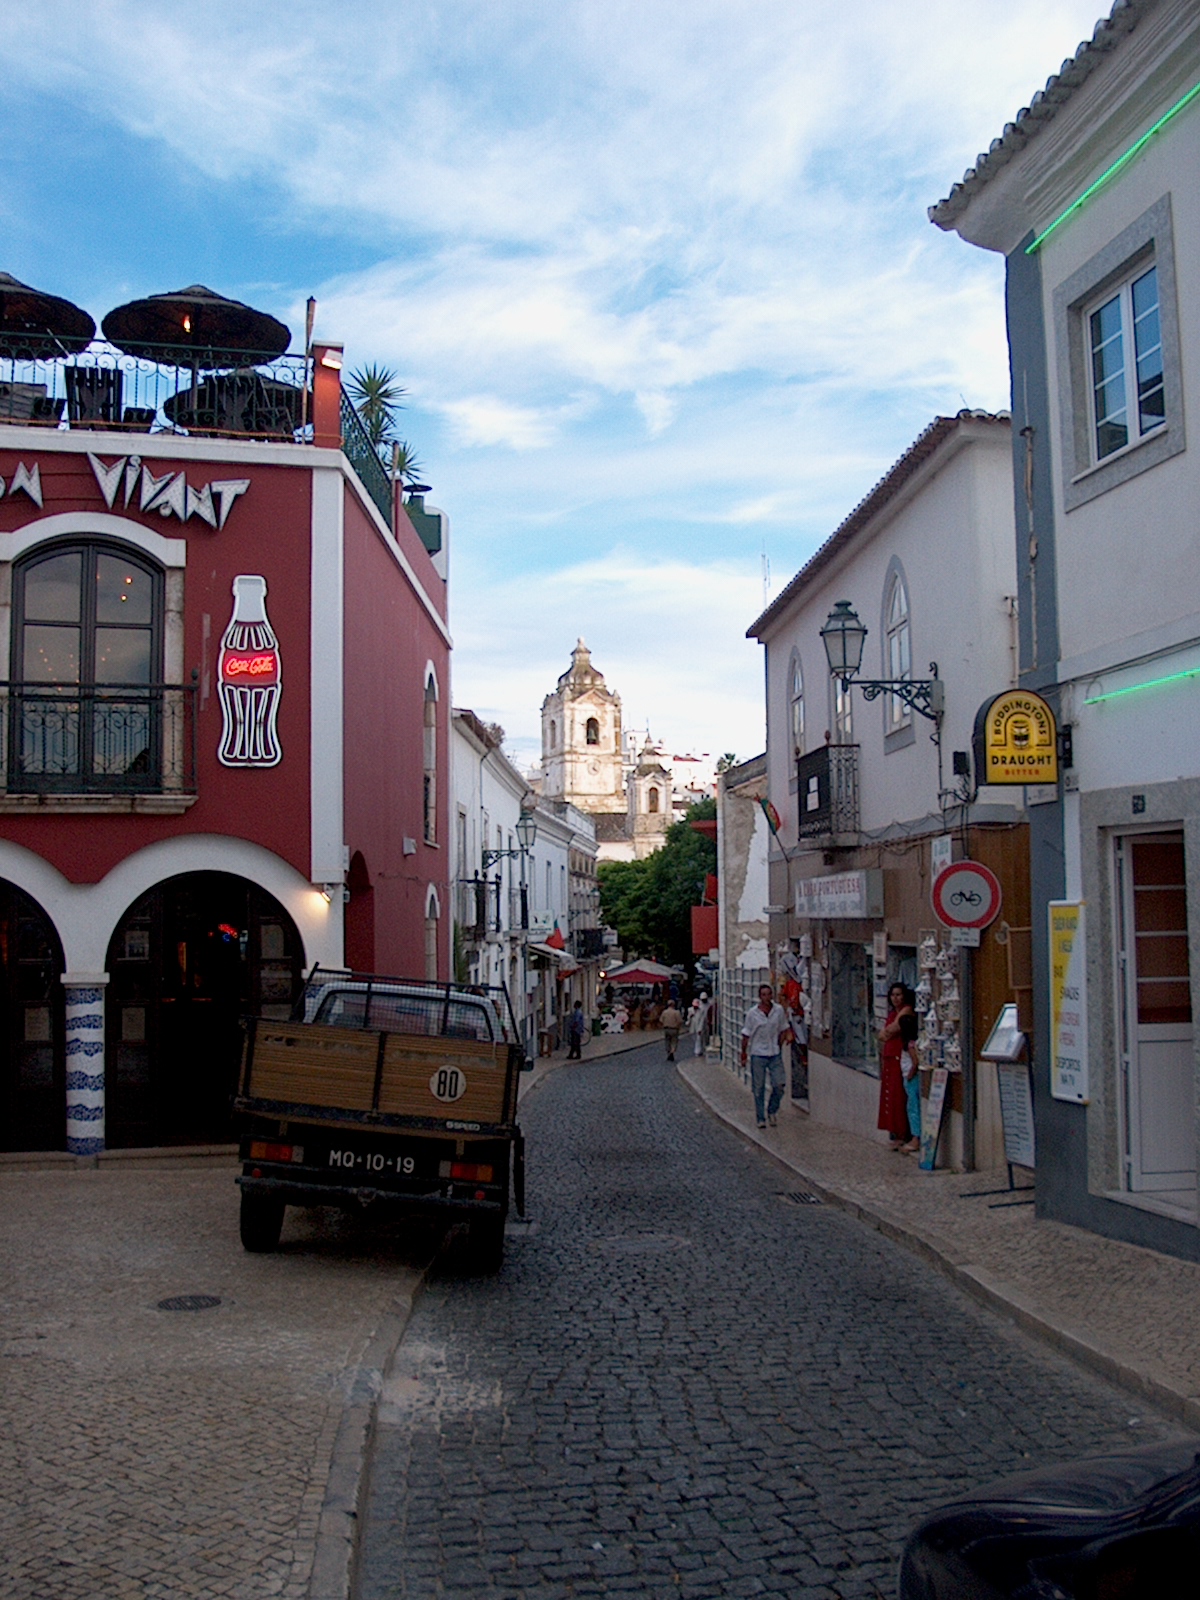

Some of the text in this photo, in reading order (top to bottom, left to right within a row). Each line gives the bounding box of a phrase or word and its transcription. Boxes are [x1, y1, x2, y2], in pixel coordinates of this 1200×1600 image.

[993, 700, 1047, 735] BODDINGTONS
[991, 755, 1052, 765] DRAUGHT
[436, 1069, 459, 1099] 80
